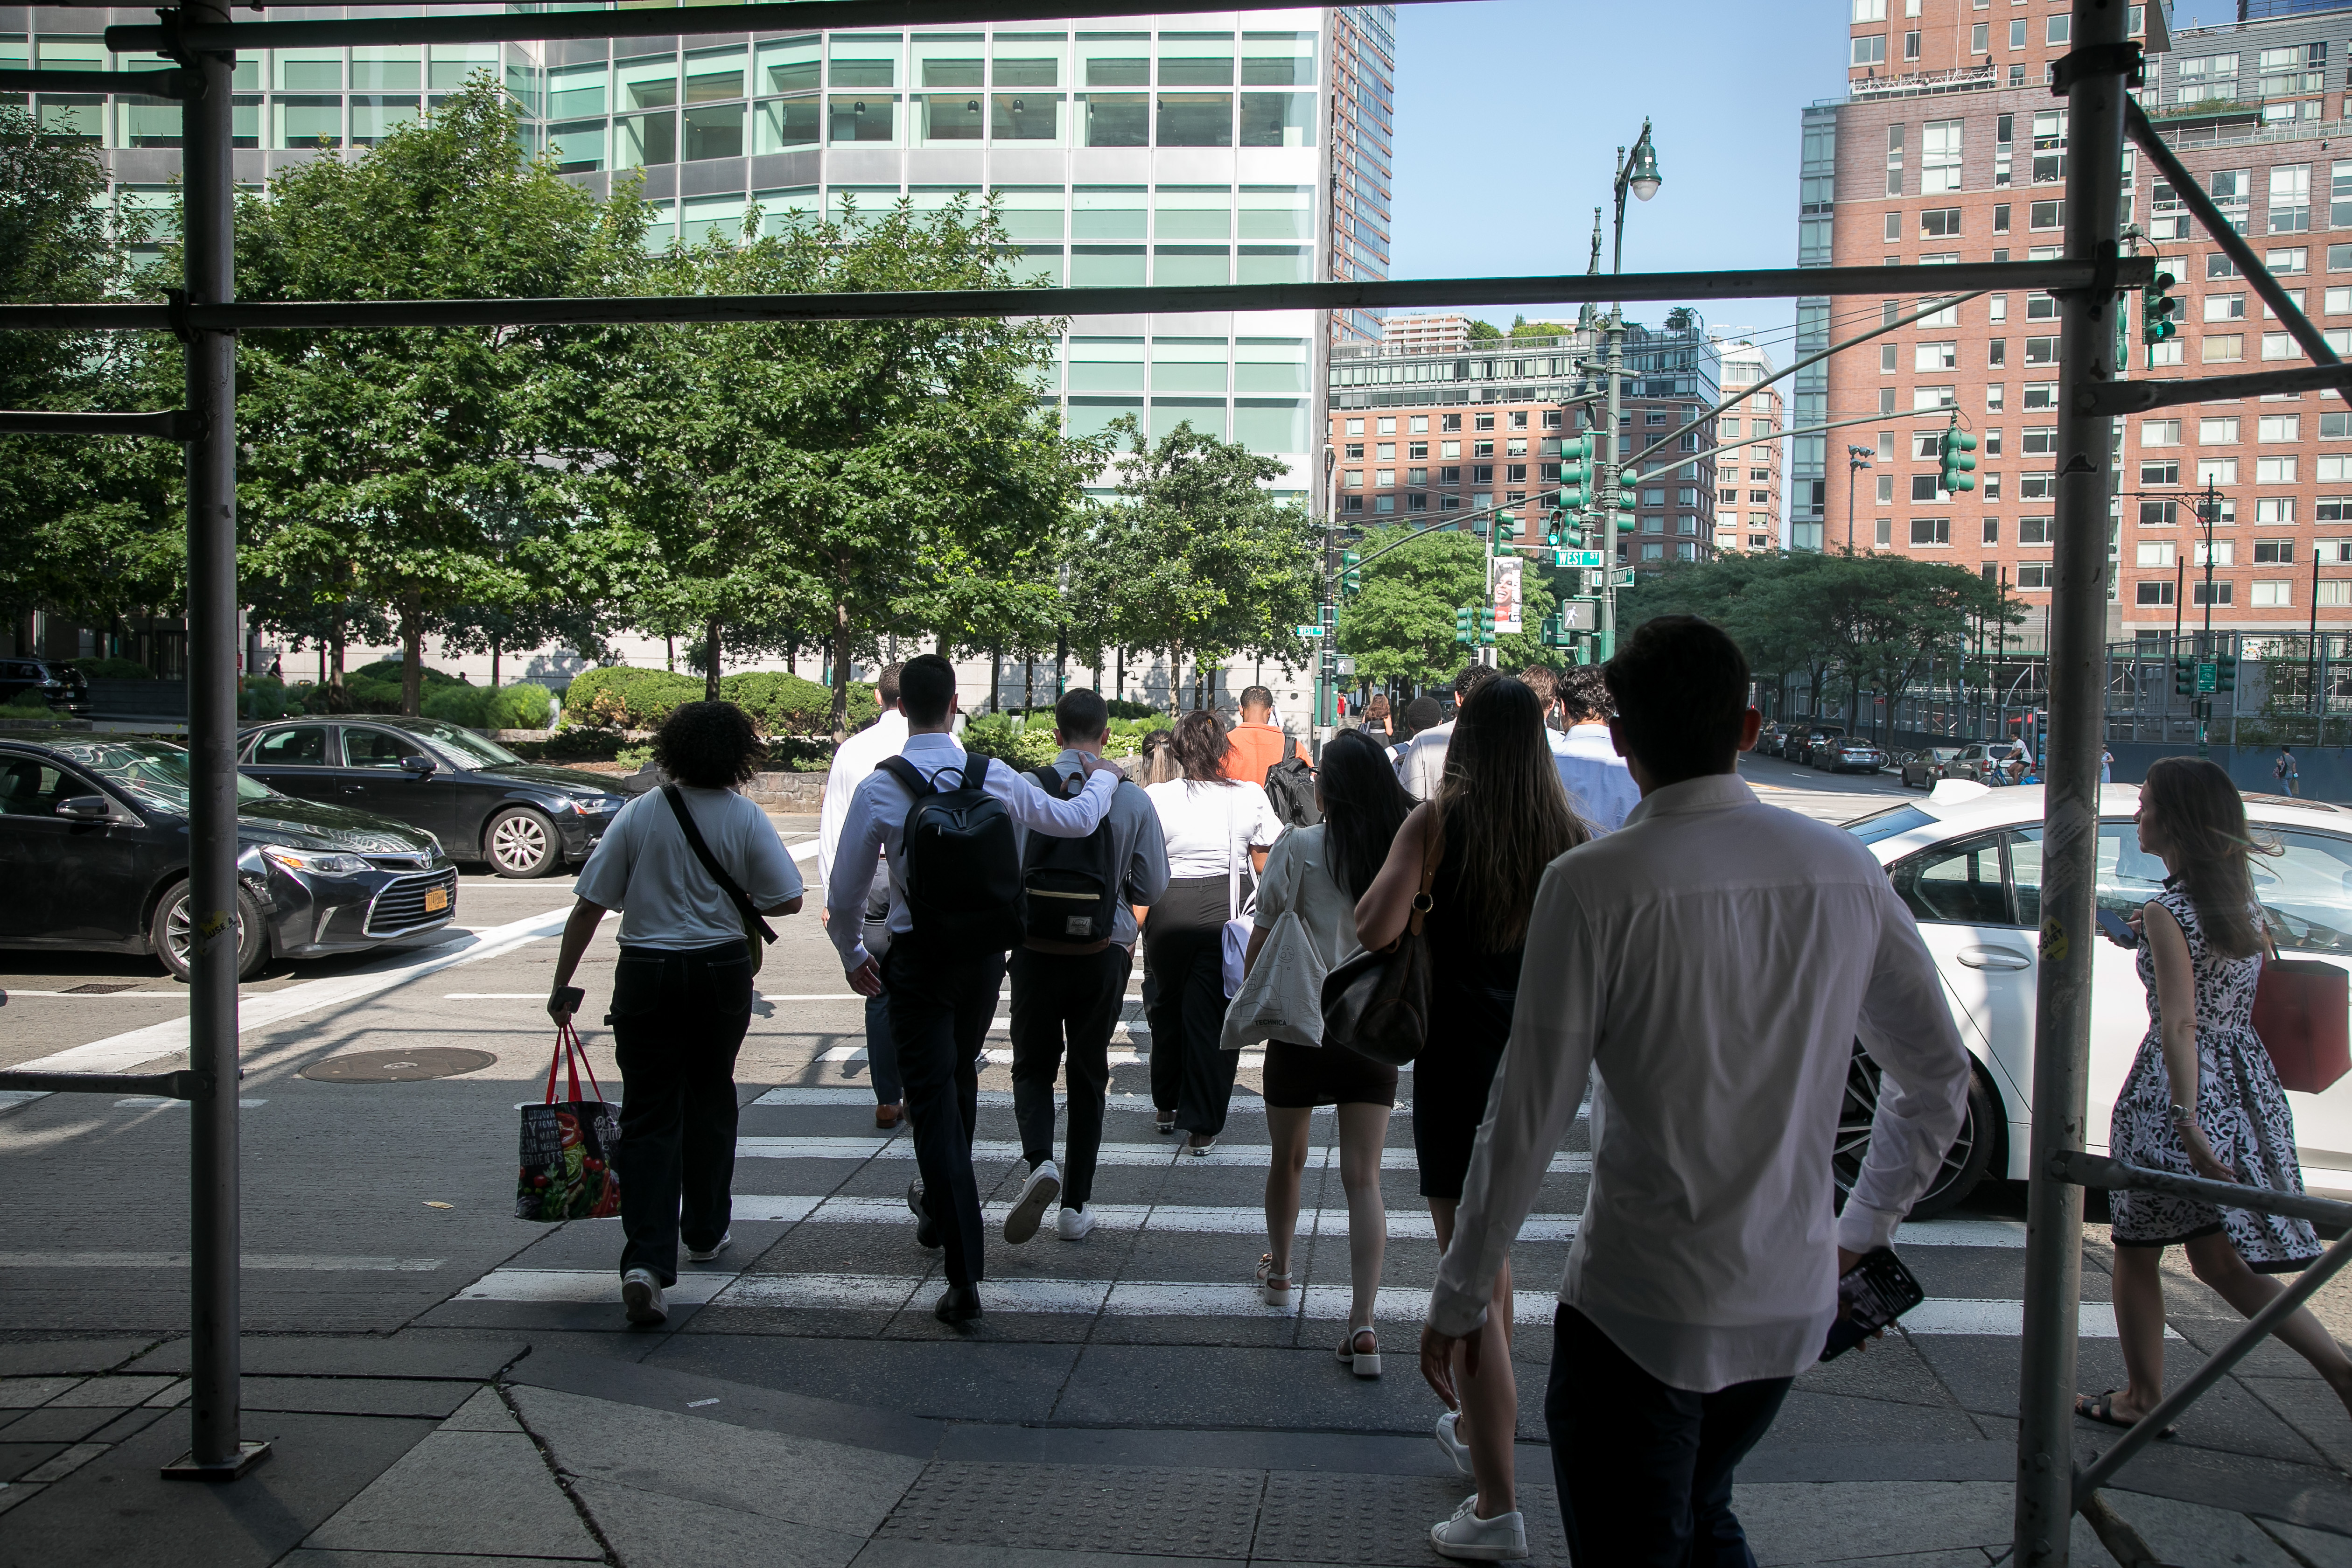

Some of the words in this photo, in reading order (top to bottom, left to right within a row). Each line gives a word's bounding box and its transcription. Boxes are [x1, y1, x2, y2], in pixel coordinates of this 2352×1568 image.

[1559, 552, 1584, 565] WEST
[1611, 569, 1628, 584] MURRAY
[228, 917, 234, 925] A
[528, 1109, 555, 1120] GROWN
[538, 1120, 558, 1129] HOME
[539, 1130, 560, 1140] MADE
[540, 1141, 561, 1151] MEALS
